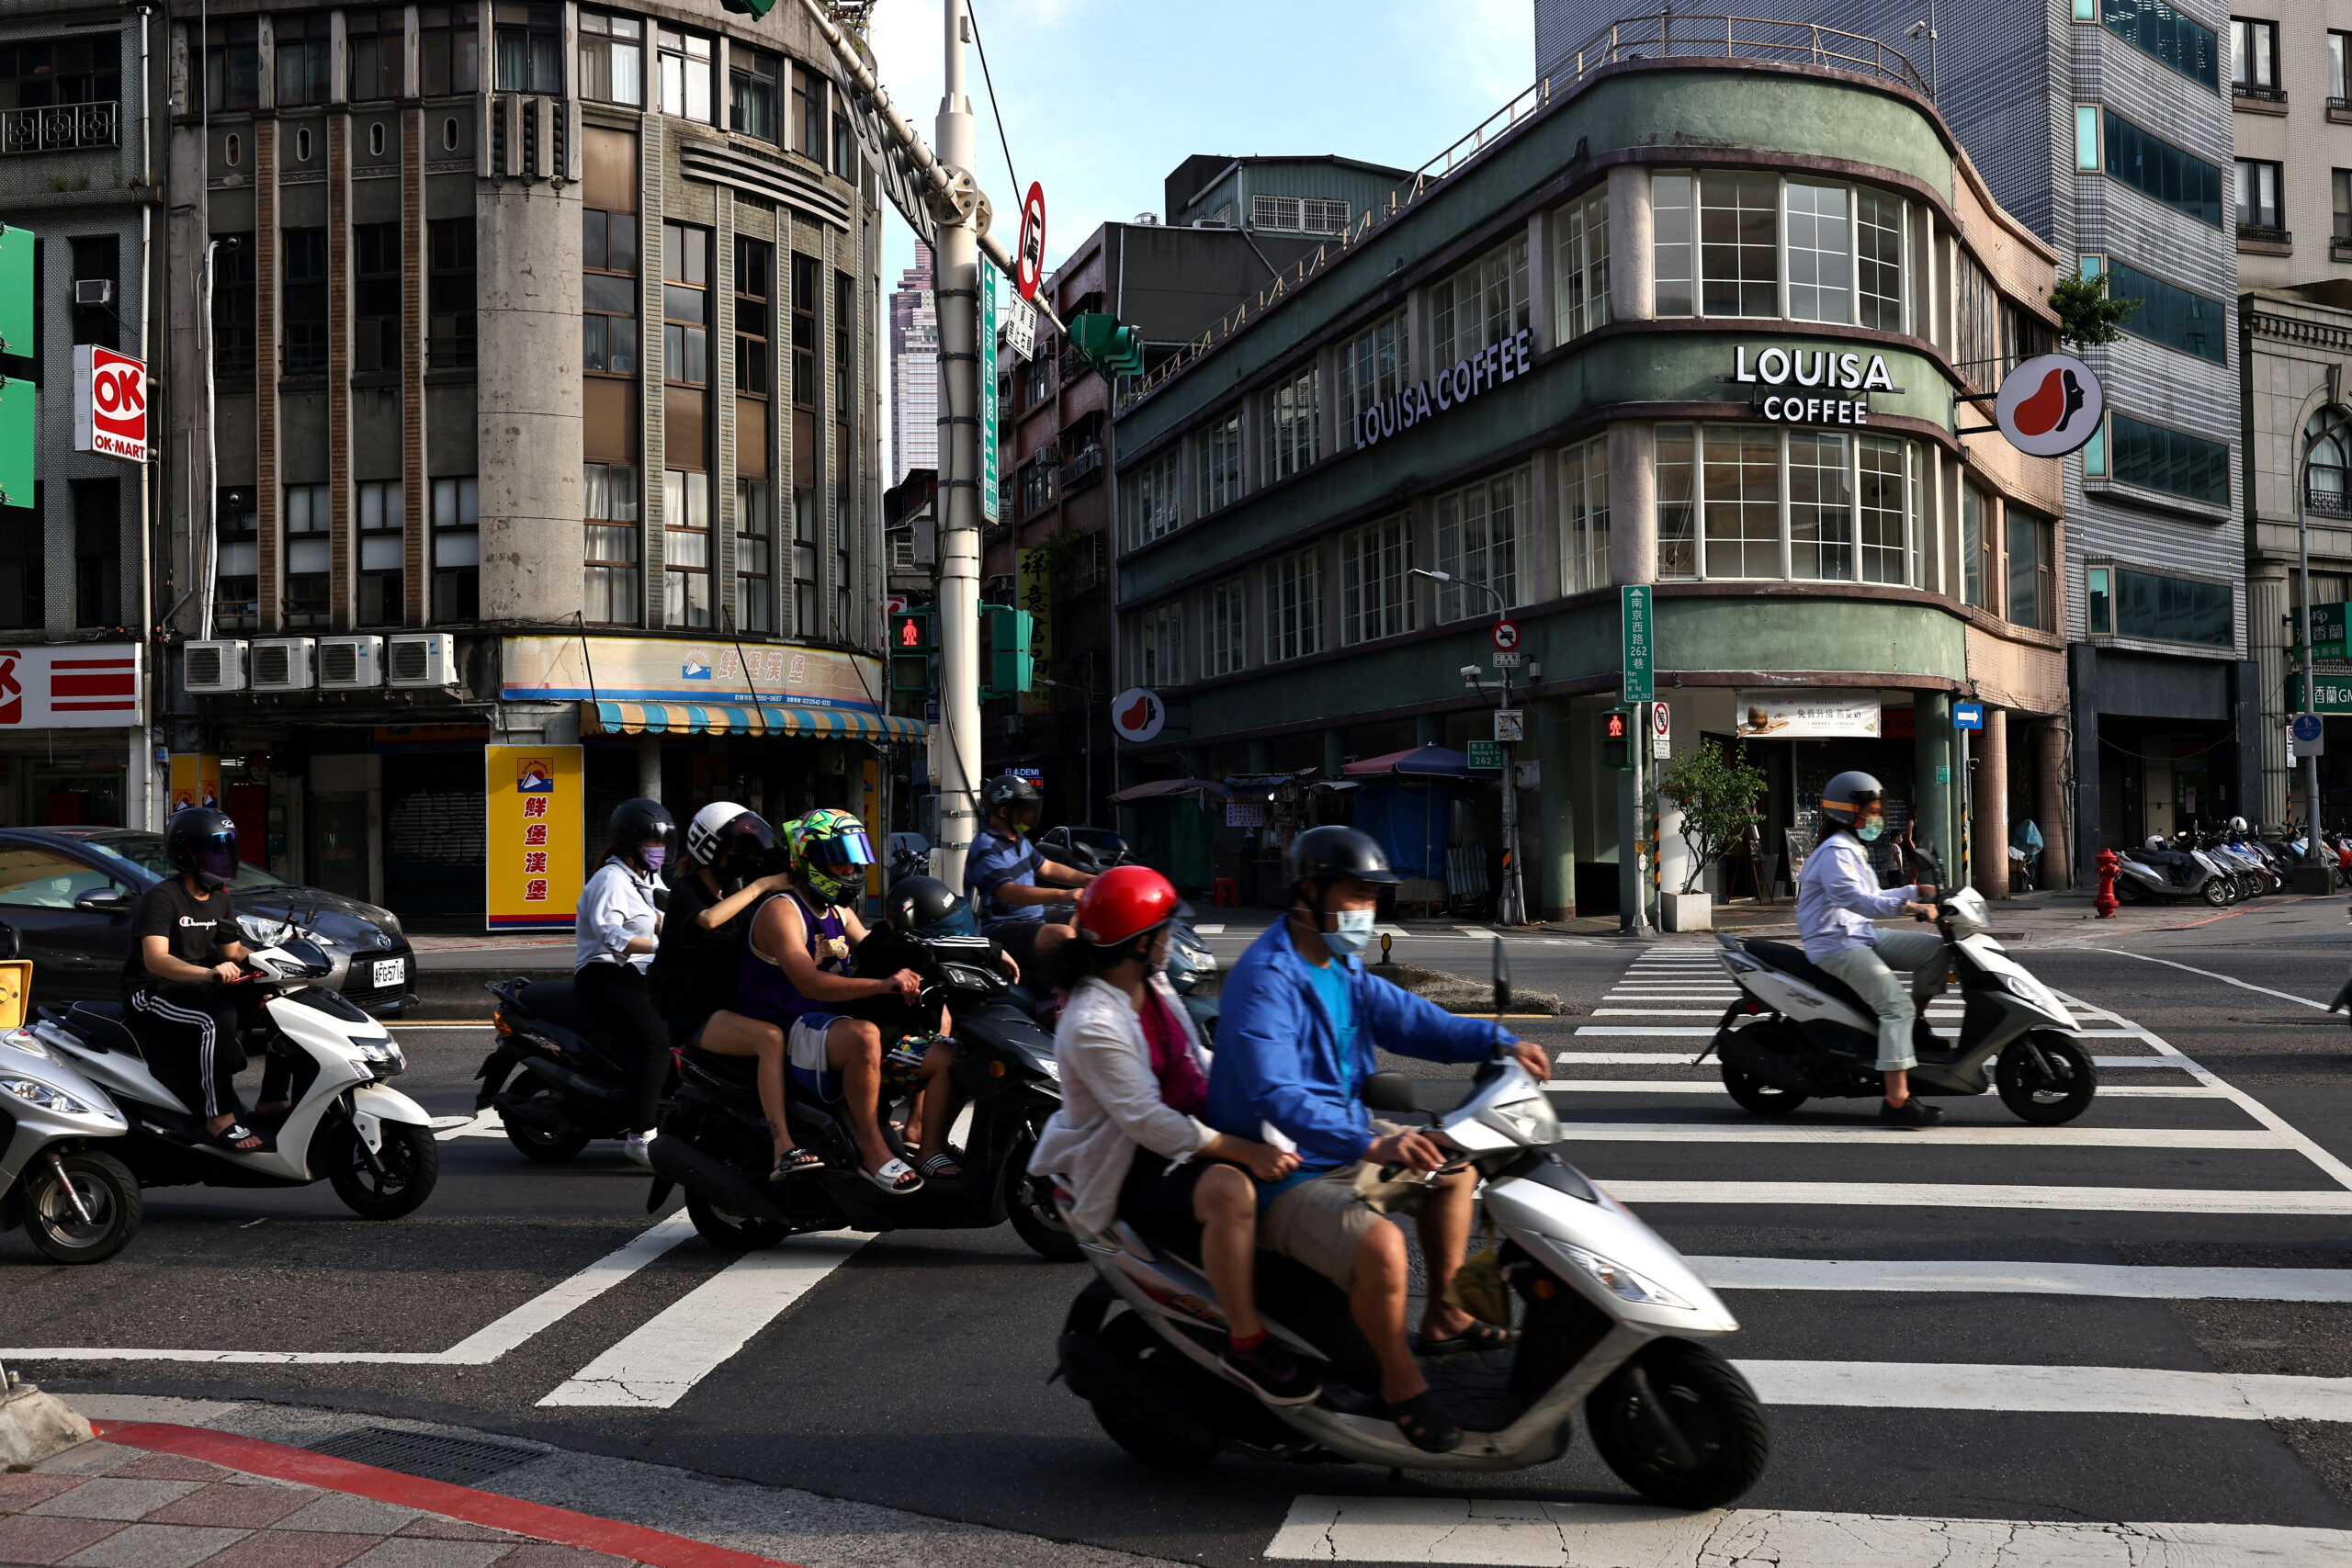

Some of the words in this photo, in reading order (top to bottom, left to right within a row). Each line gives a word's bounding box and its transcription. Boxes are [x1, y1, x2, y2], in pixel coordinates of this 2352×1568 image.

[986, 289, 995, 423] 南京西路
[1736, 345, 1894, 390] LOUISA
[94, 369, 145, 412] OK
[1355, 380, 1432, 451] LOUISA
[1437, 327, 1532, 412] COFFEE
[1763, 396, 1869, 424] COFFEE
[2297, 625, 2344, 642] 香蘭
[718, 649, 805, 683] 鮮堡漢堡
[1797, 708, 1834, 719] 免費升級
[1475, 757, 1492, 765] 262
[524, 795, 548, 902] 鮮堡漢堡
[179, 916, 217, 931] Champi
[375, 964, 404, 983] AFG-5716
